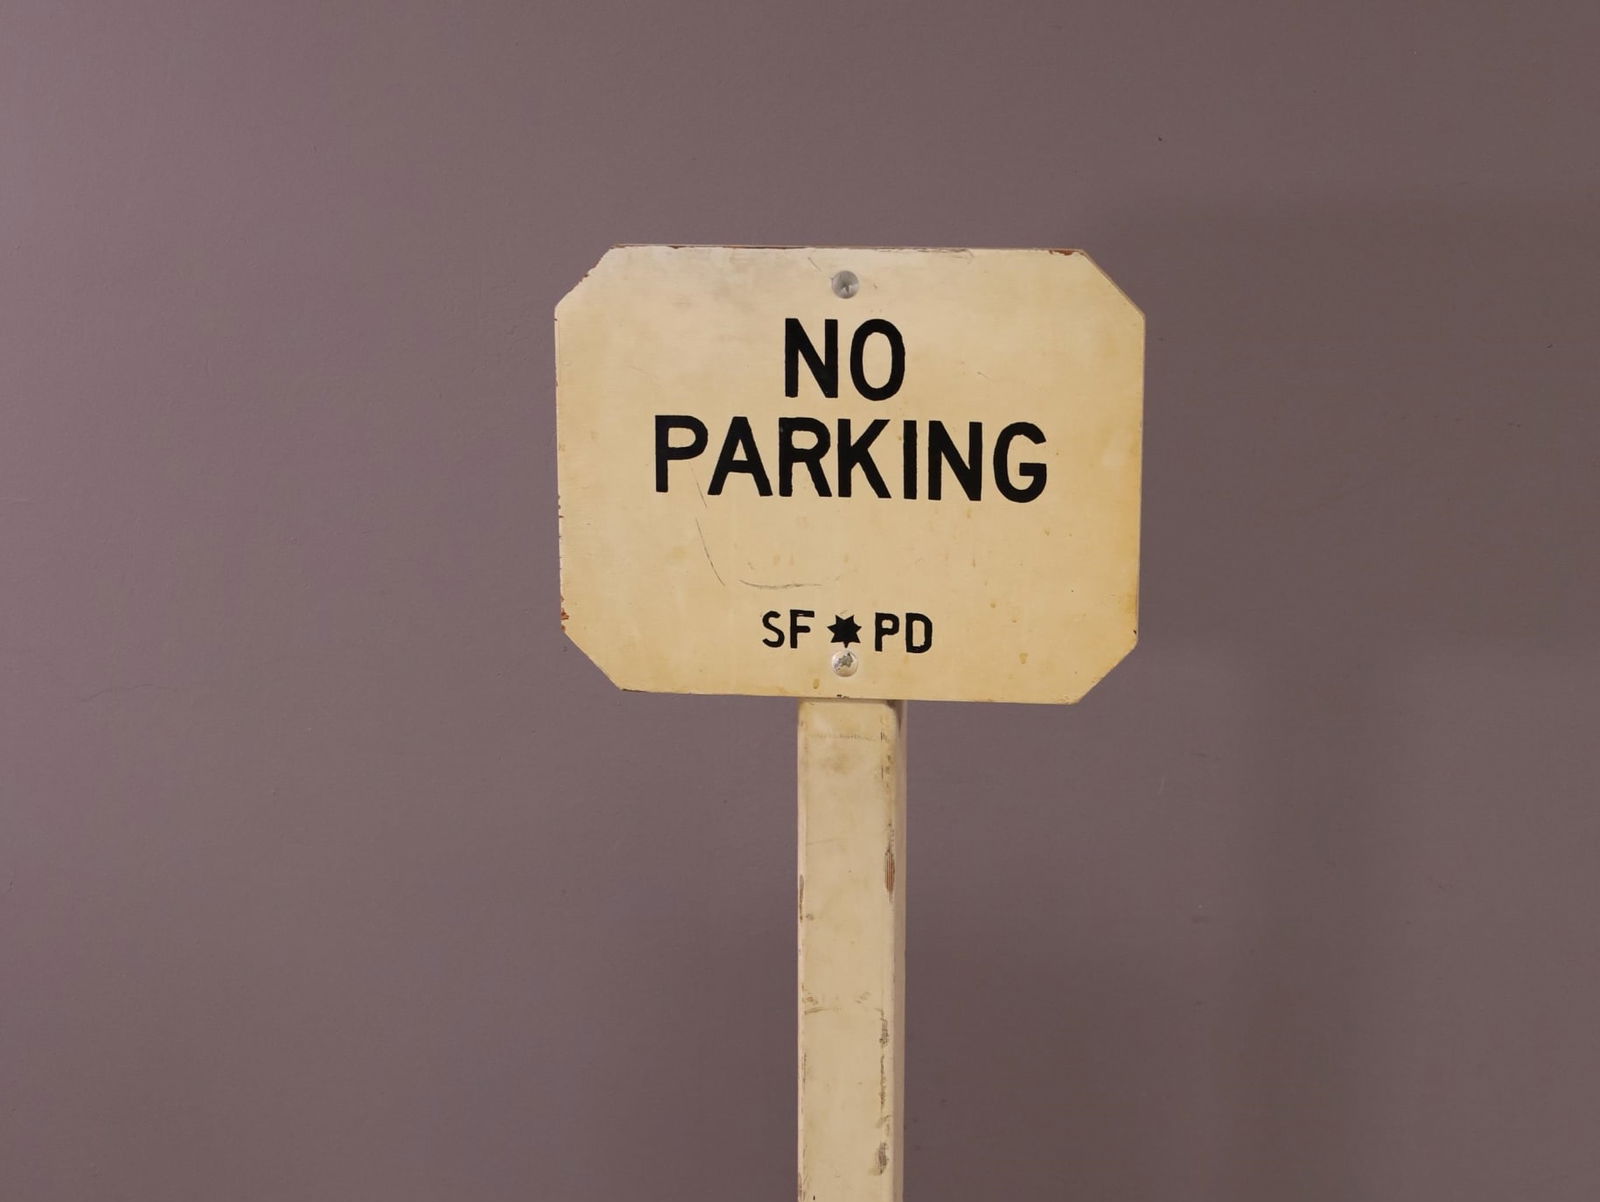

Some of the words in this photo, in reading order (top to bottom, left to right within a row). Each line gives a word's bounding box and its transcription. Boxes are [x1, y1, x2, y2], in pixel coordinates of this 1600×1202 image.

[784, 317, 906, 402] NO
[655, 414, 1048, 504] PARKING
[762, 609, 815, 649] SF
[874, 612, 933, 654] PD
